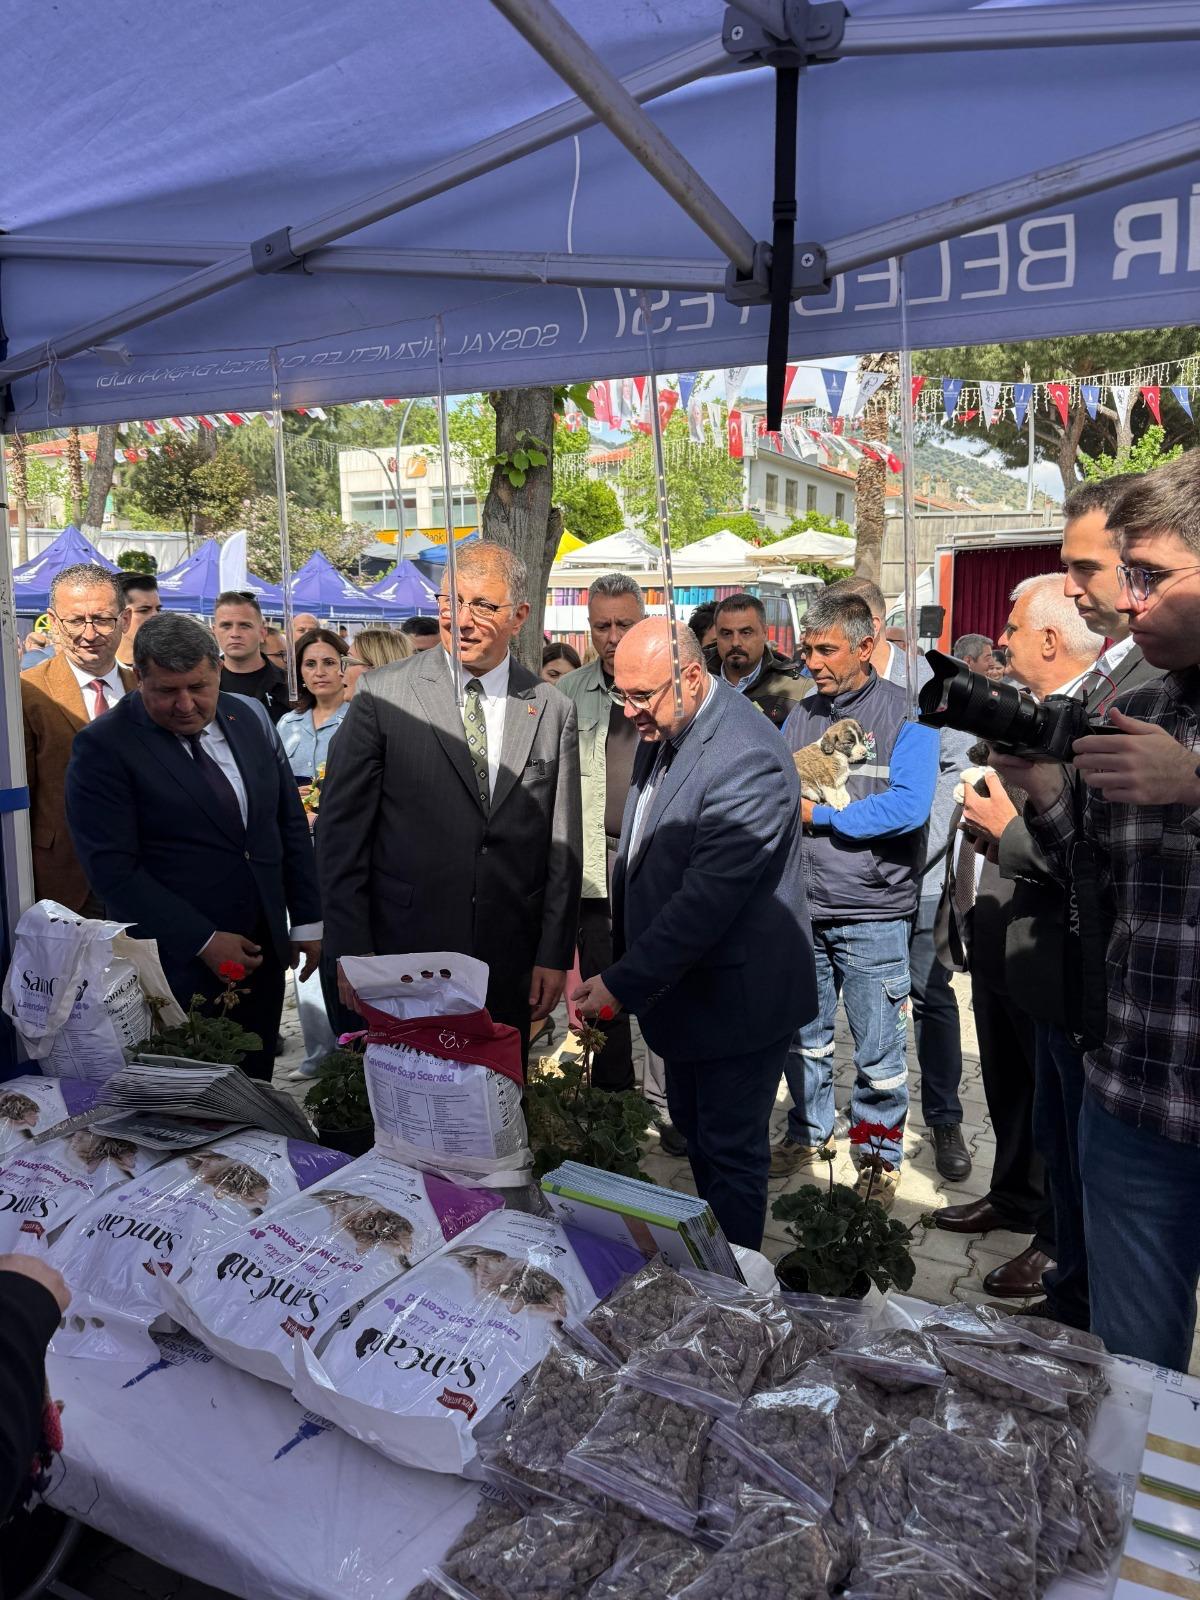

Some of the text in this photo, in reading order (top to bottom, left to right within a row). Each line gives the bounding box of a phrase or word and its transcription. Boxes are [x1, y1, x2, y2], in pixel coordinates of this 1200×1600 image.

[398, 1066, 416, 1080] Soap
[417, 1071, 455, 1082] Scented
[264, 1223, 306, 1253] Scented
[217, 1253, 329, 1323] SamCat
[355, 1327, 485, 1389] SamCat
